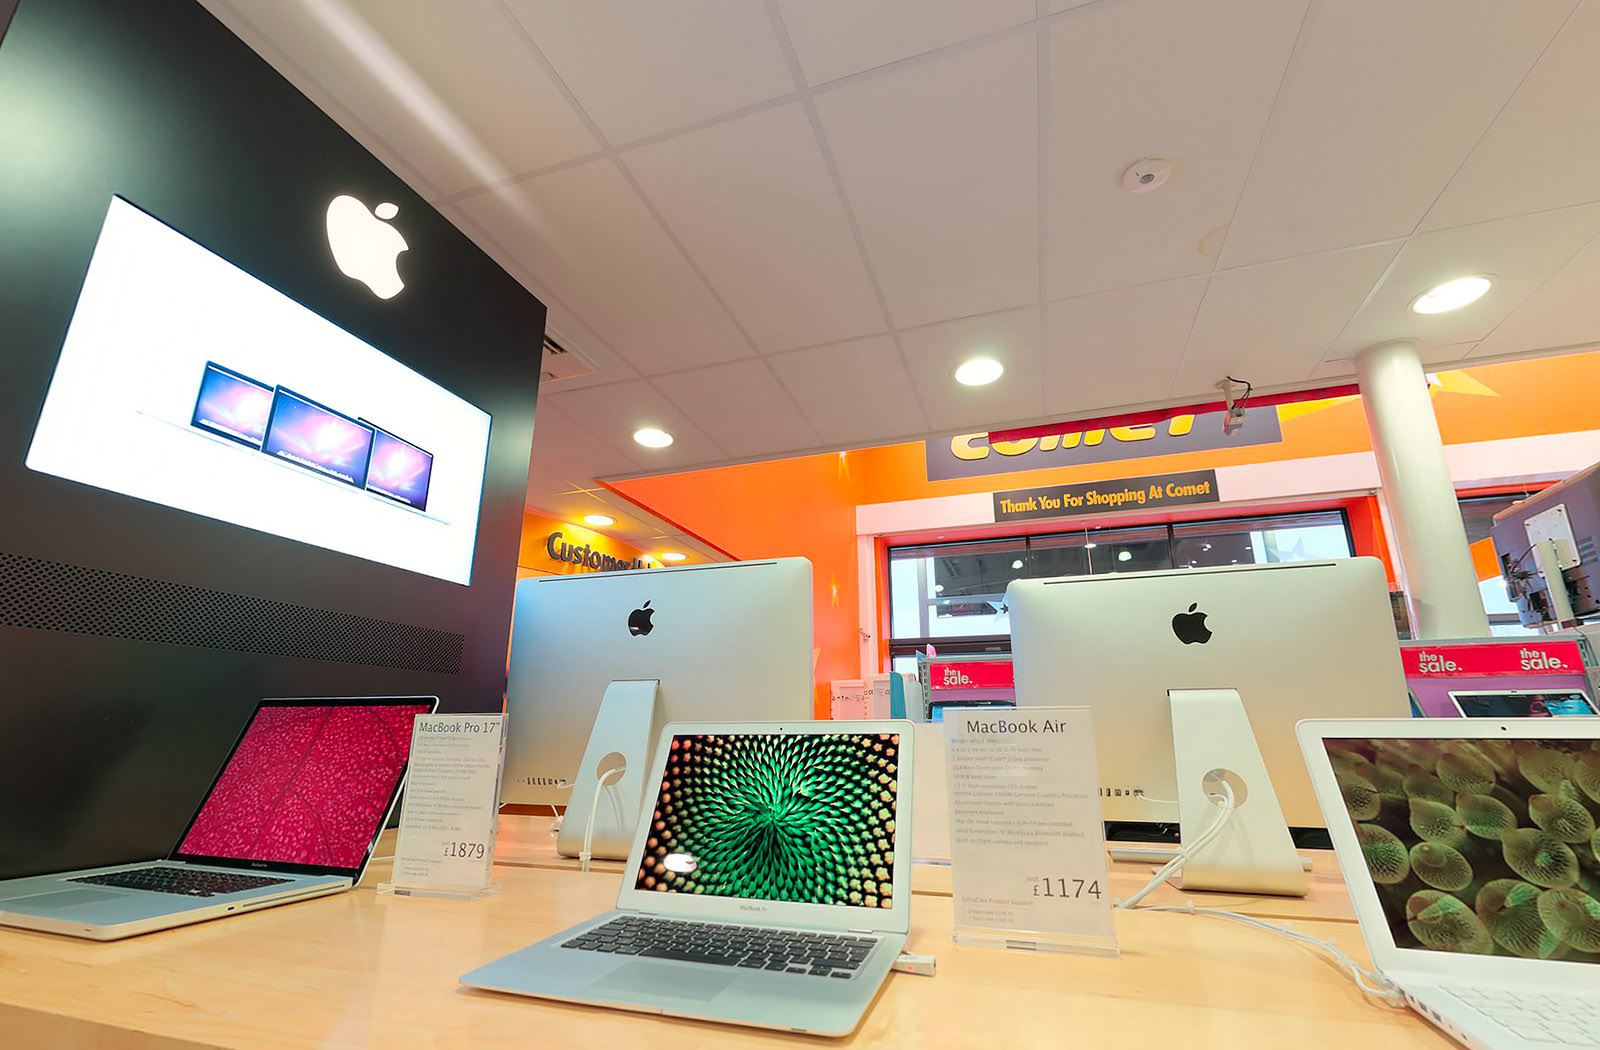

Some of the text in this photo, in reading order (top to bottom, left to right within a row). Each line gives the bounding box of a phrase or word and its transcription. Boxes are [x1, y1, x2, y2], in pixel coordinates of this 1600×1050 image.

[1000, 480, 1211, 515] Thank You For Shopping At Comet
[1419, 651, 1438, 662] the
[1520, 648, 1539, 659] the
[1418, 655, 1463, 673] sale.
[1520, 652, 1568, 671] sale.
[943, 671, 973, 686] sale.
[944, 667, 957, 676] the
[419, 721, 462, 734] MacBook
[464, 722, 480, 734] Pro
[967, 720, 1066, 734] MacBook Air
[444, 842, 485, 860] £1879
[1033, 877, 1102, 900] £1174
